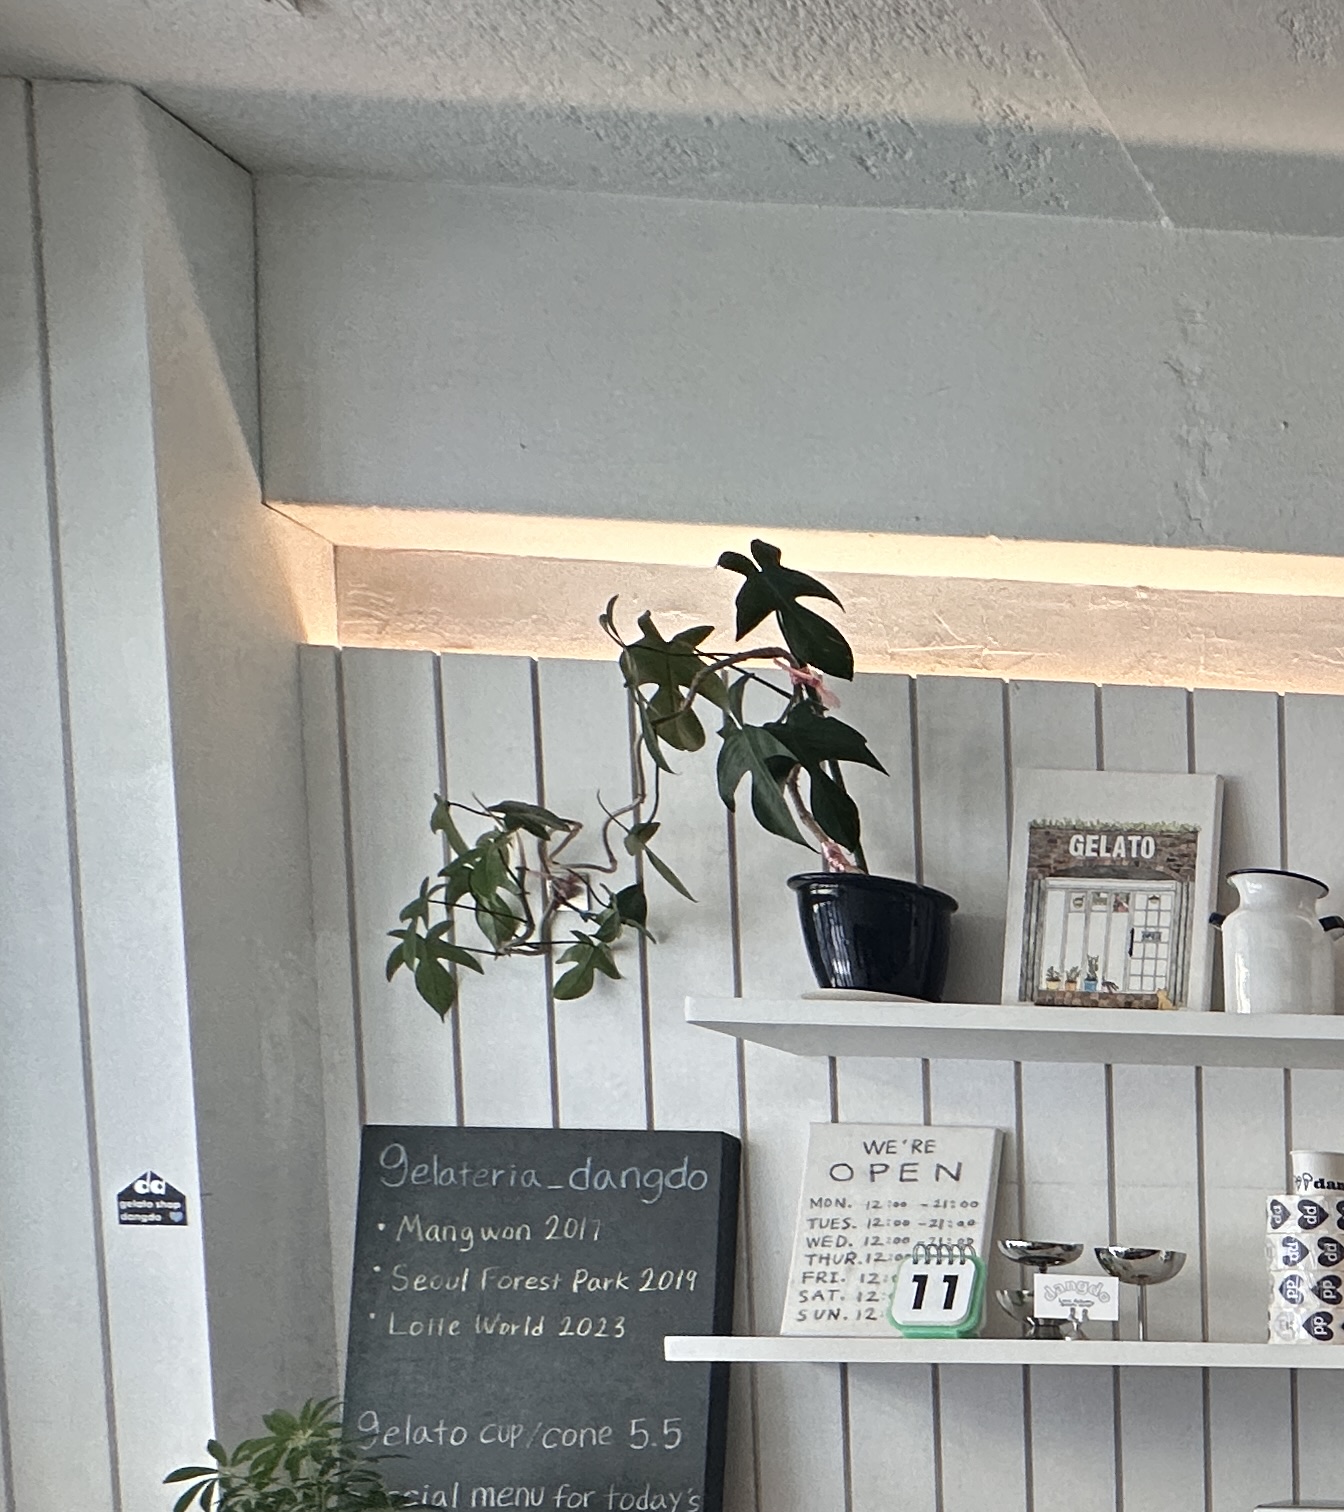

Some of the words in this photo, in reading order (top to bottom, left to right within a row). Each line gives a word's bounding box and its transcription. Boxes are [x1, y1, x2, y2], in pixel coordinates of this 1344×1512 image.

[1069, 835, 1156, 859] GELATO
[863, 1139, 937, 1155] WE'RE
[829, 1162, 963, 1183] OPEN
[810, 1197, 853, 1209] MON.
[545, 1214, 603, 1243] 2017
[806, 1217, 858, 1230] TUES.
[806, 1236, 853, 1248] WED.
[805, 1252, 863, 1266] THUR.
[391, 1264, 468, 1292] Seoul
[481, 1265, 563, 1292] Forest
[572, 1268, 630, 1293] Park
[638, 1267, 698, 1293] 2019
[802, 1271, 847, 1285] FRI.
[799, 1290, 845, 1303] SAT.
[911, 1274, 960, 1311] 11
[1043, 1280, 1111, 1303] dangdo
[475, 1313, 545, 1338] World
[558, 1314, 626, 1338] 2023
[796, 1308, 848, 1322] SUN.
[357, 1409, 467, 1451] gelato
[628, 1417, 683, 1450] 5.5
[378, 1481, 459, 1508] cial
[471, 1484, 546, 1508] menu
[555, 1484, 596, 1510] for
